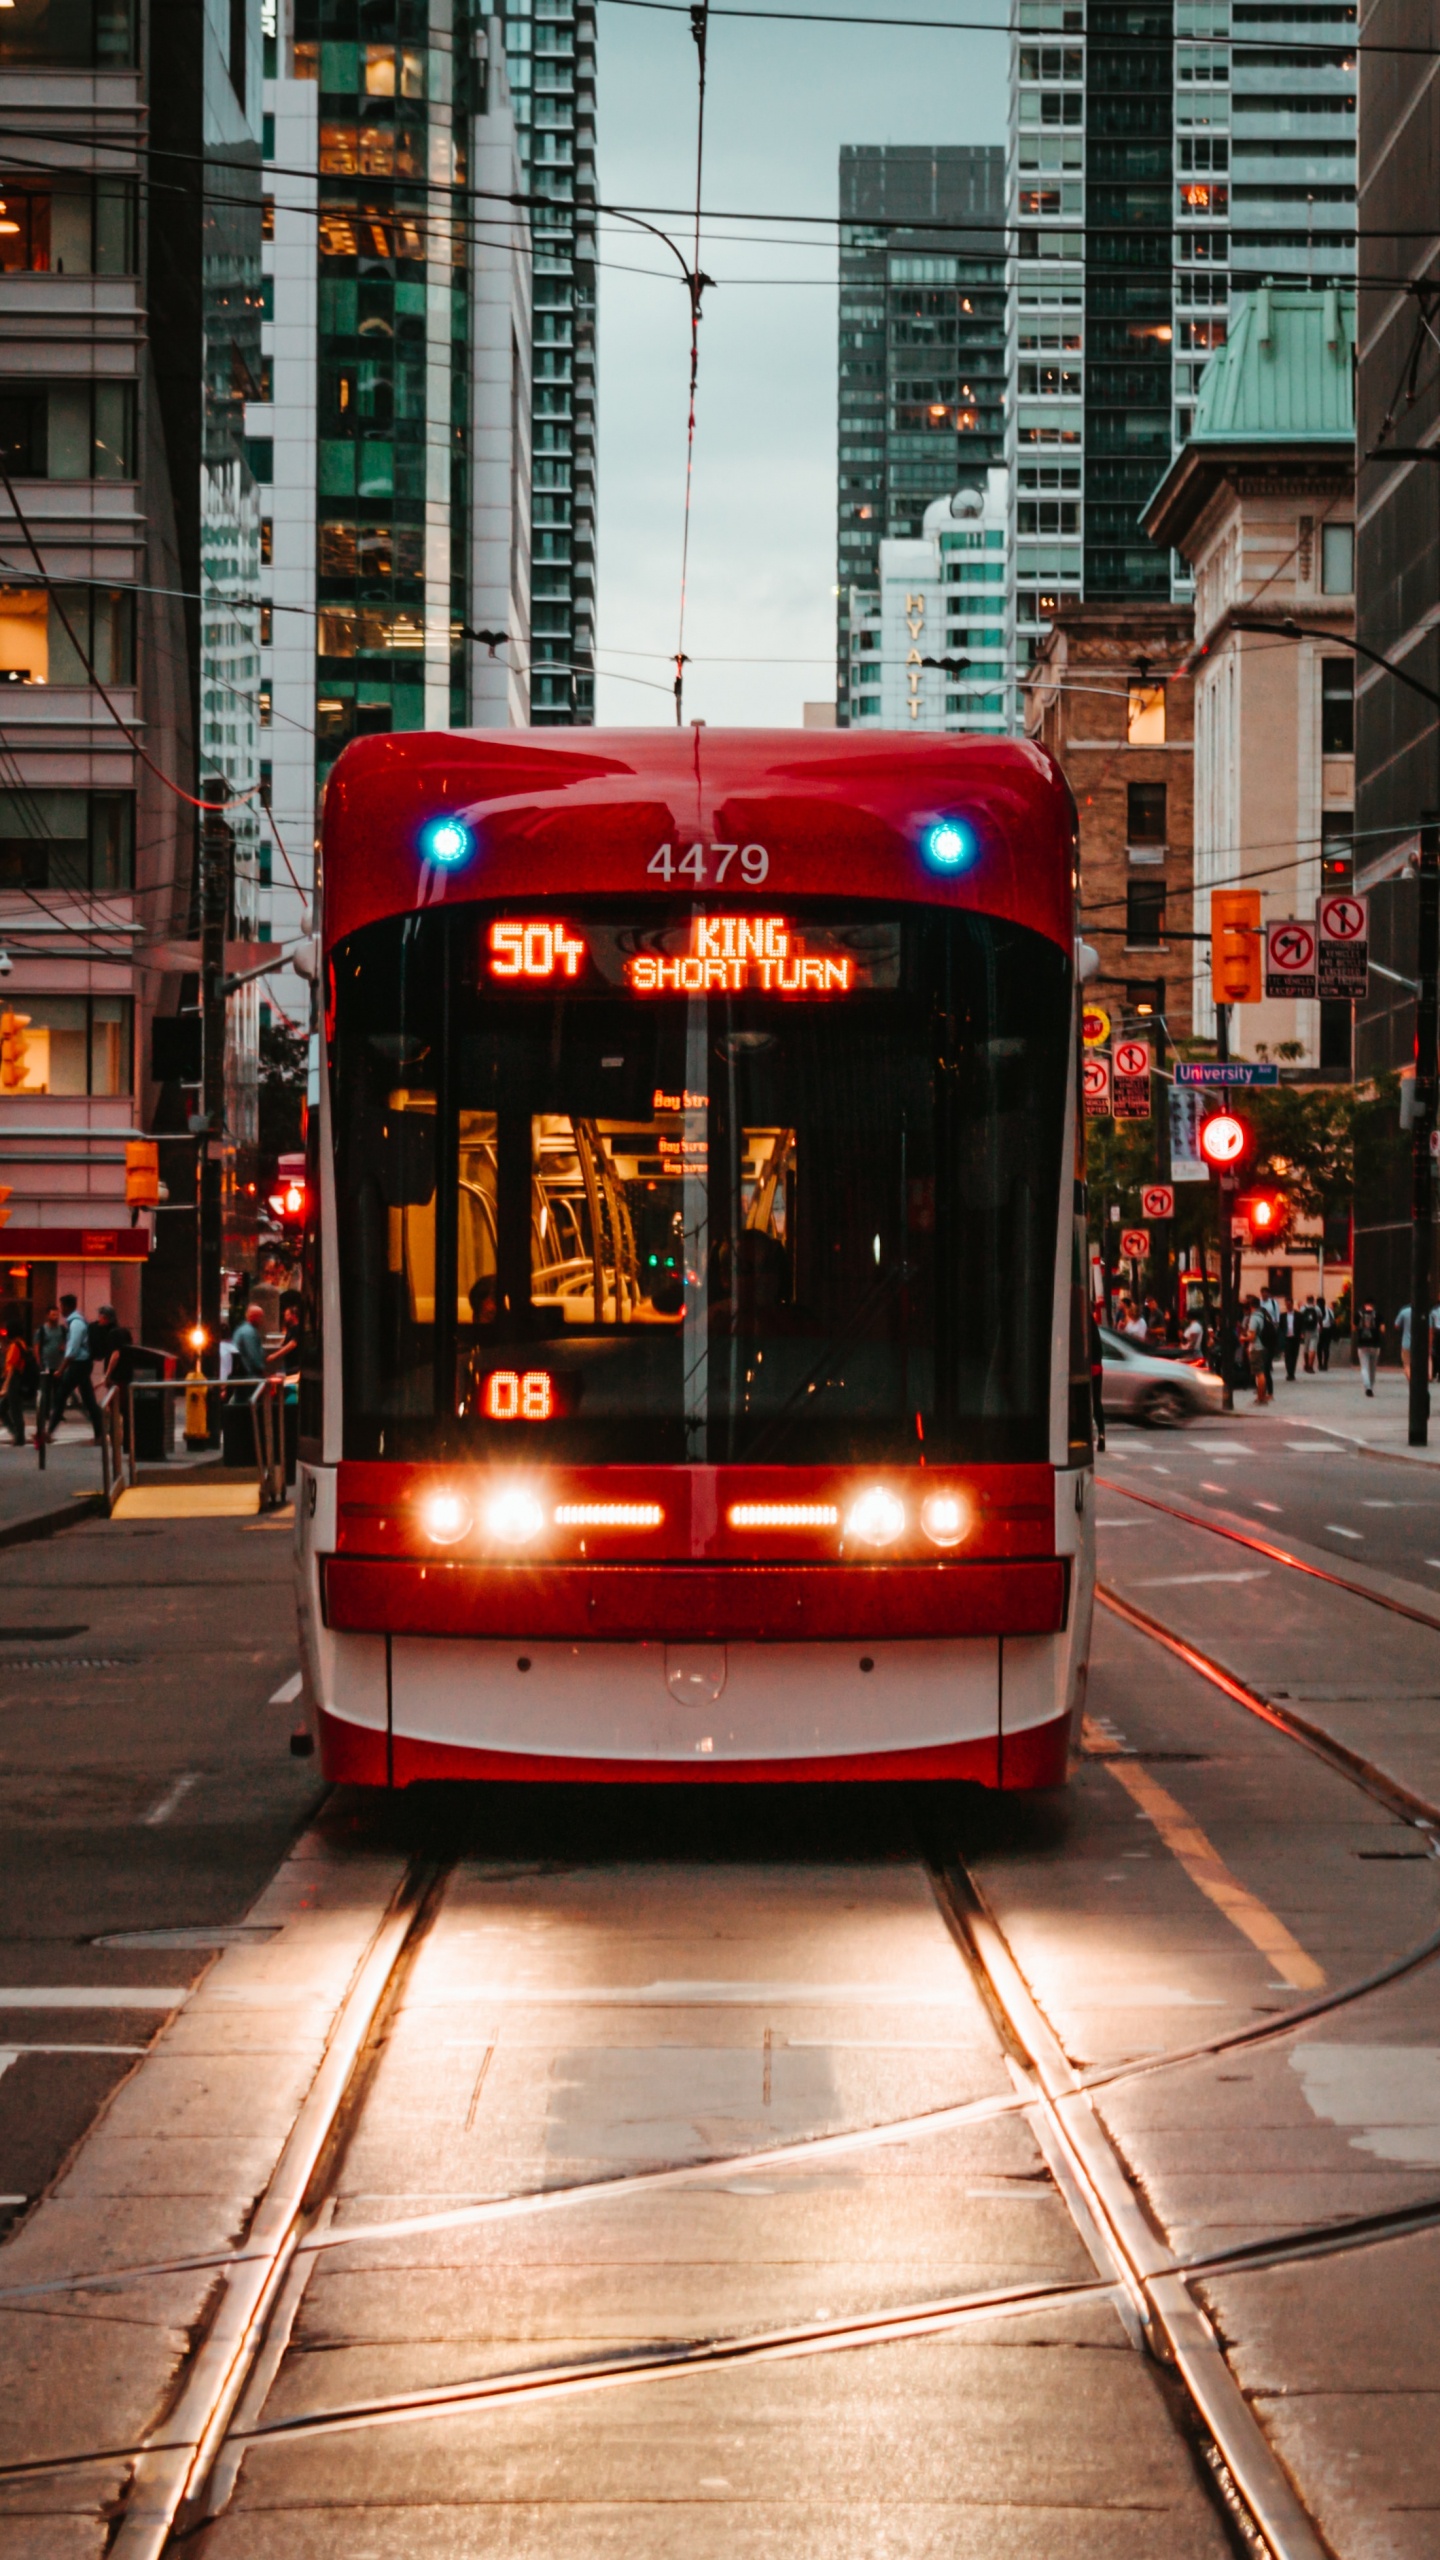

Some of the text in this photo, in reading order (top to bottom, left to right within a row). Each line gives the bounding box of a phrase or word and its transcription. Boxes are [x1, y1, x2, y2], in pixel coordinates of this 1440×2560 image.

[905, 592, 924, 721] HYATT
[646, 843, 770, 884] 4479
[490, 922, 585, 976] 504
[696, 917, 788, 958] KING
[632, 958, 849, 989] SHORT TURN
[1180, 1066, 1253, 1083] University
[653, 1089, 681, 1111] Bay
[490, 1371, 551, 1418] 08
